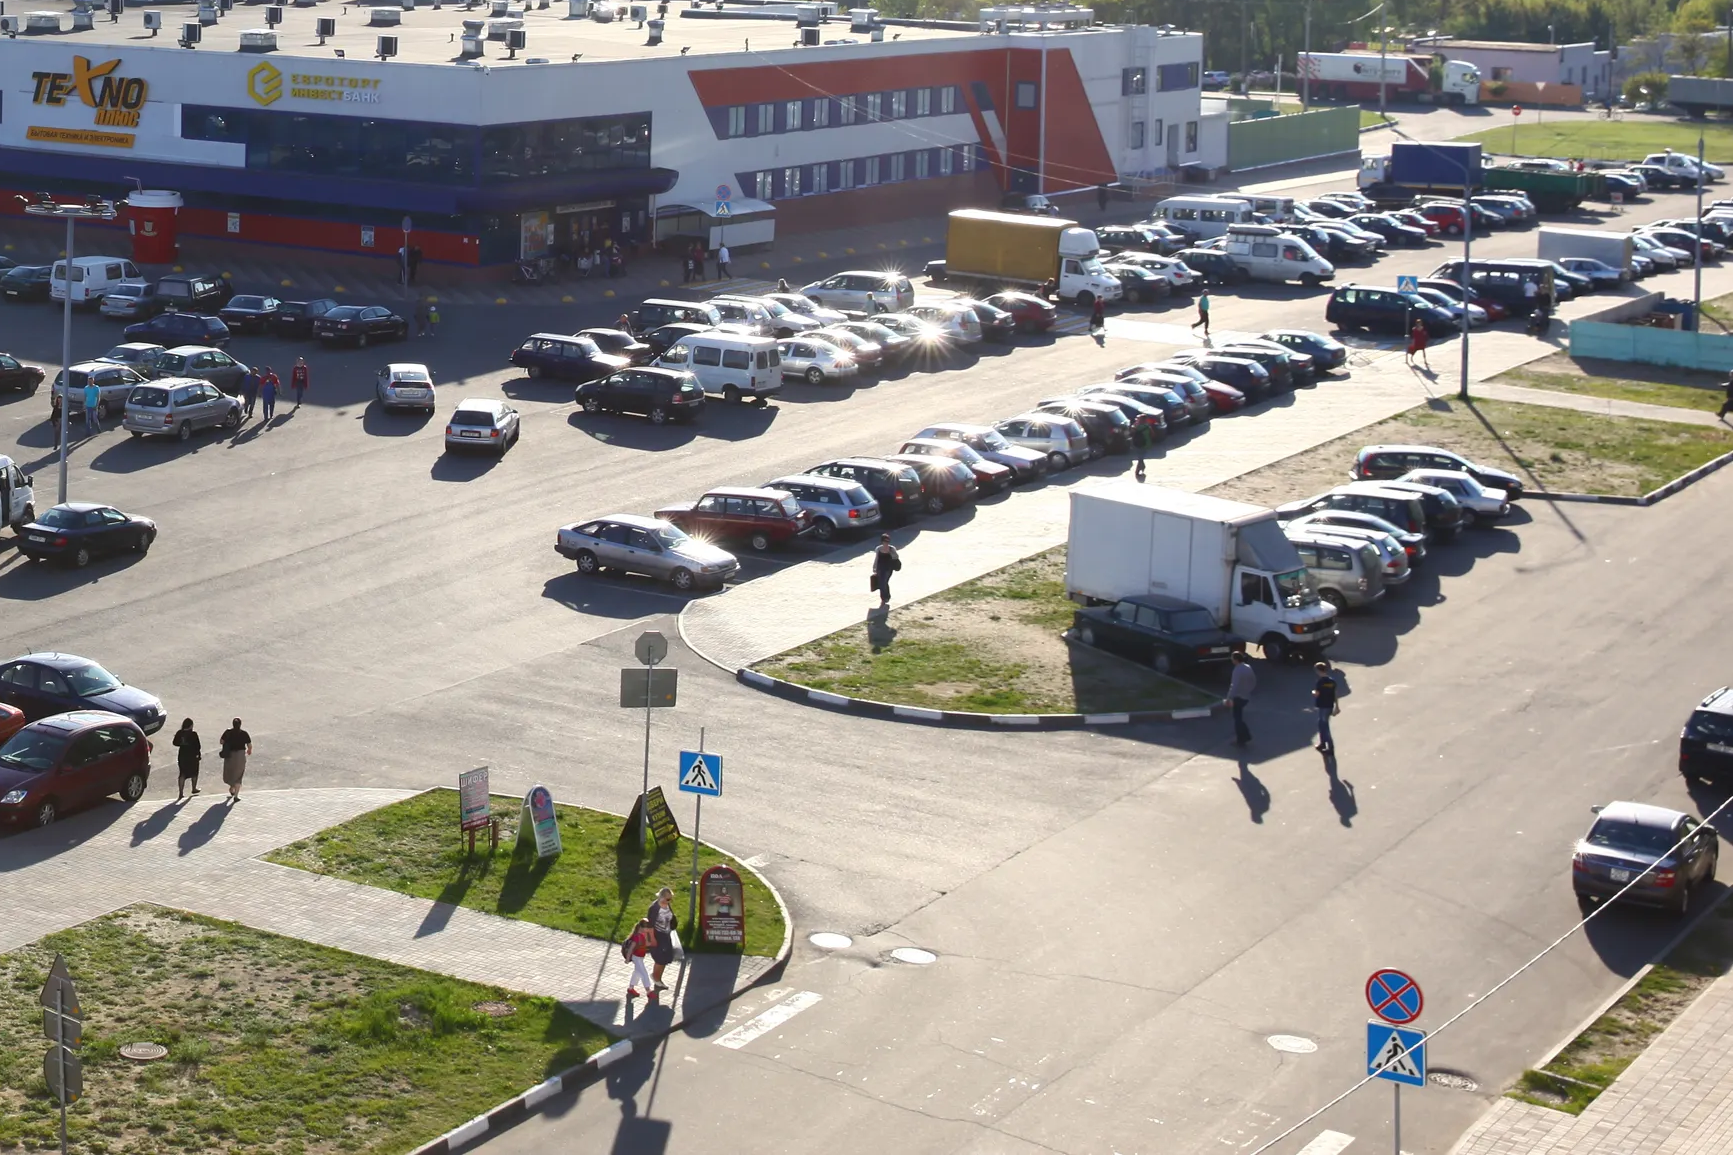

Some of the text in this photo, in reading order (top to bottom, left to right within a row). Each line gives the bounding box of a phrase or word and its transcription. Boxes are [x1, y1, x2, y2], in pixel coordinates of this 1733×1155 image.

[291, 73, 382, 90] ЕВРОТОРГ
[30, 129, 58, 138] БЫТОВАЯ
[59, 131, 83, 140] ТЕХНИКА
[87, 133, 129, 144] ЭЛЕКТРОНИКА
[460, 771, 488, 787] ШИФЕР
